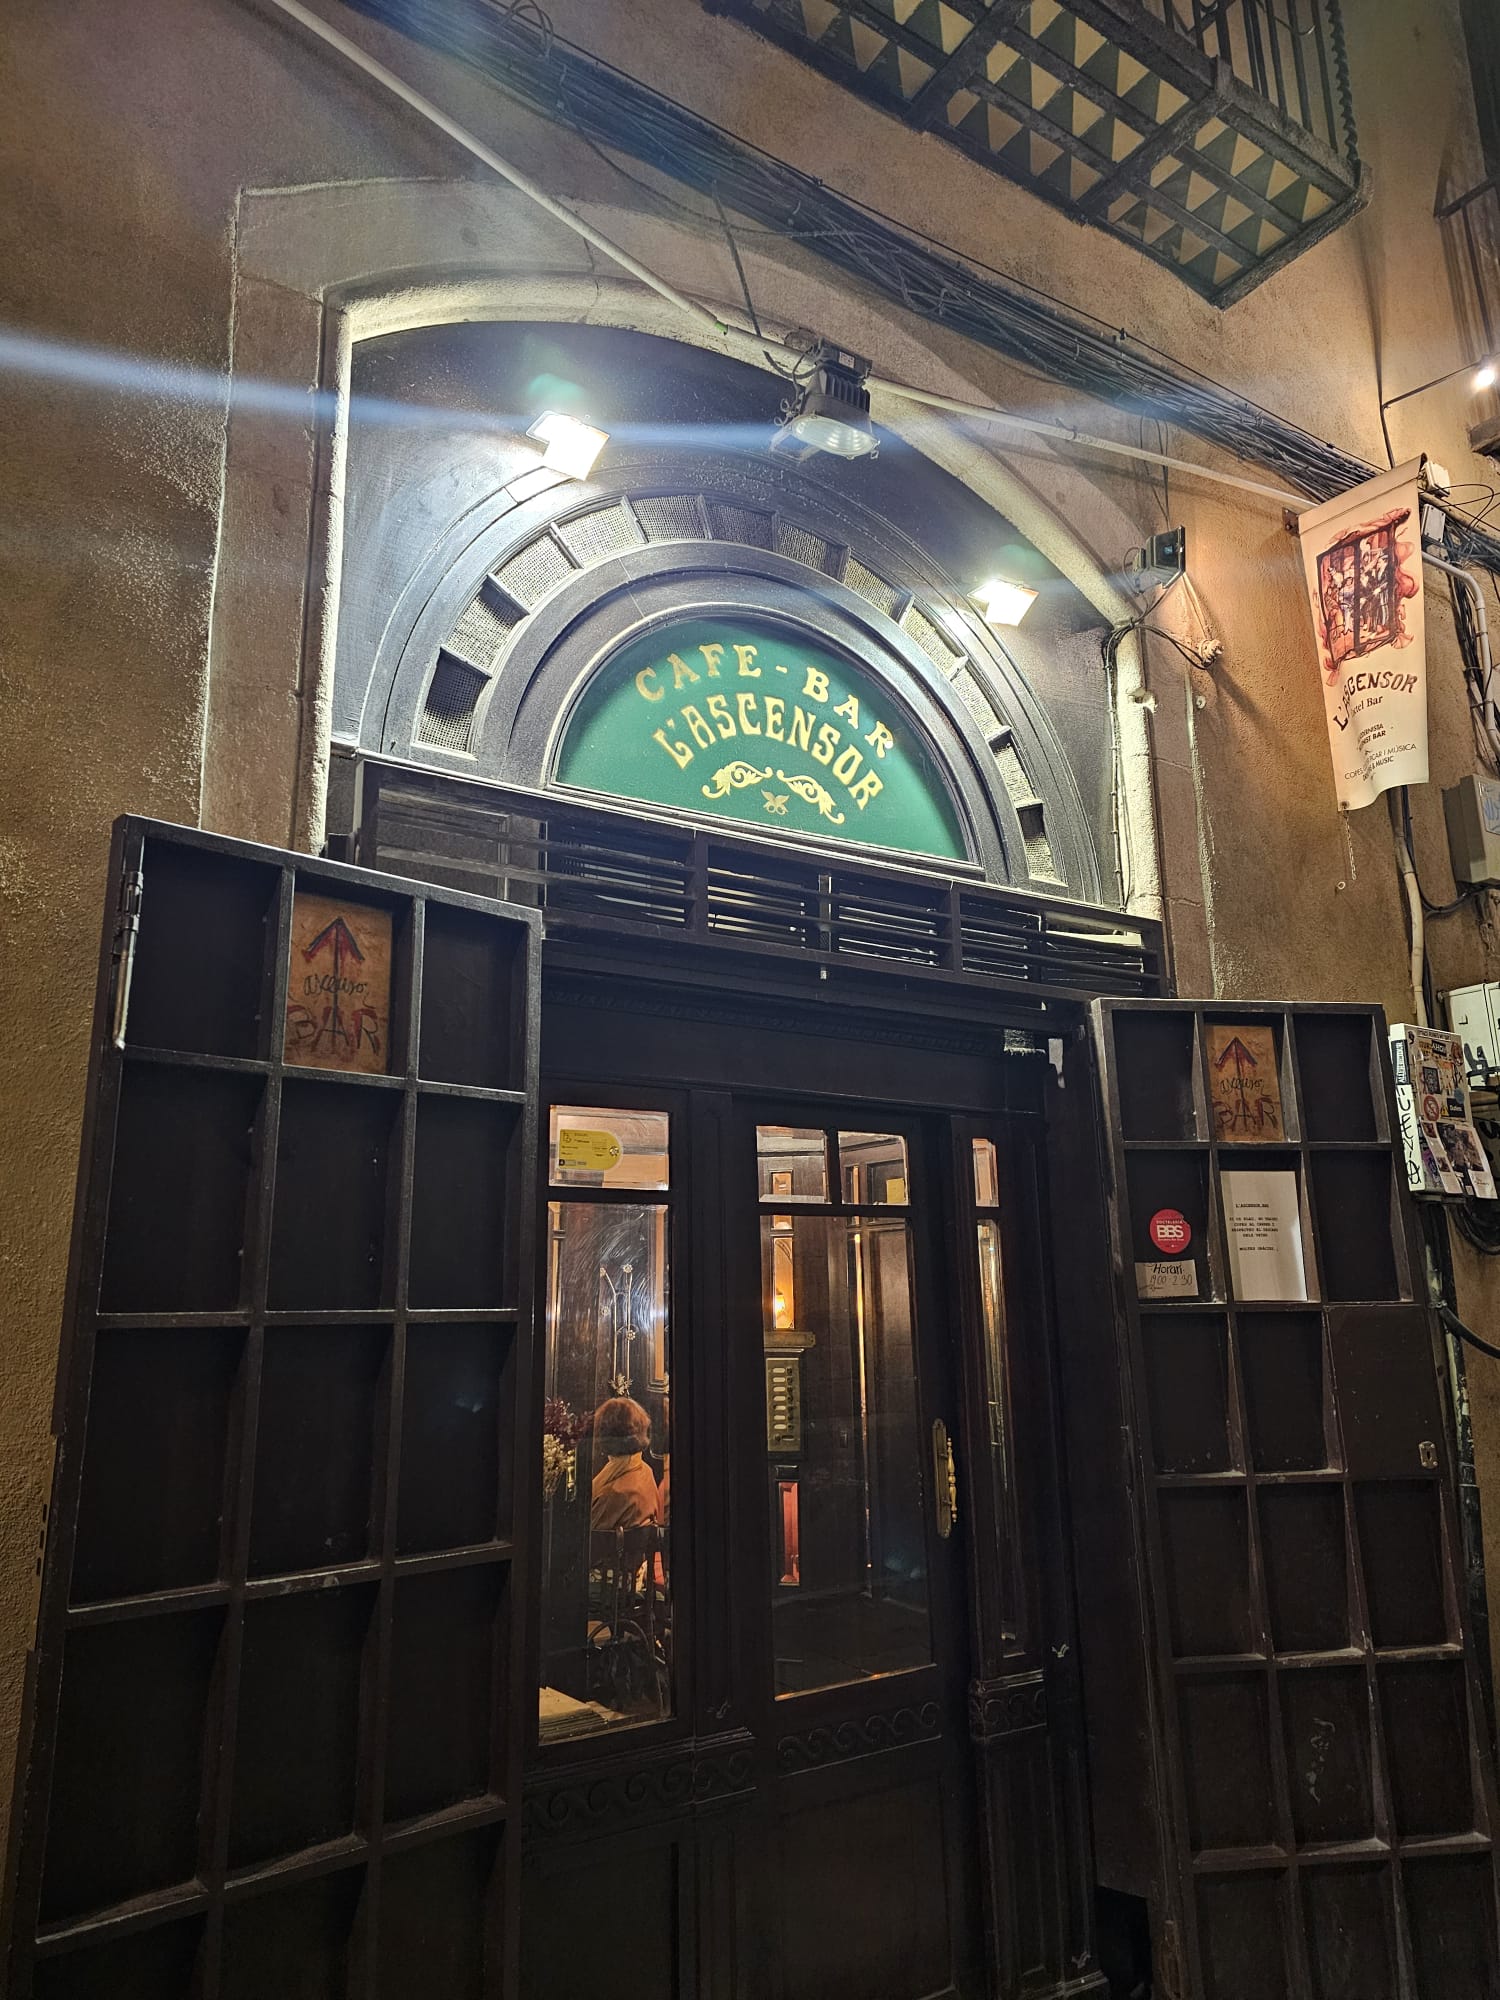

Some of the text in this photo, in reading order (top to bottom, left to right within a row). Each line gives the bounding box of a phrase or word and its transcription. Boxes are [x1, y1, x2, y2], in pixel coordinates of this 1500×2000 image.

[1366, 696, 1384, 708] Bar
[1372, 730, 1387, 740] BAR
[652, 692, 884, 811] L'ASCENSOR
[1156, 1224, 1184, 1238] BBS
